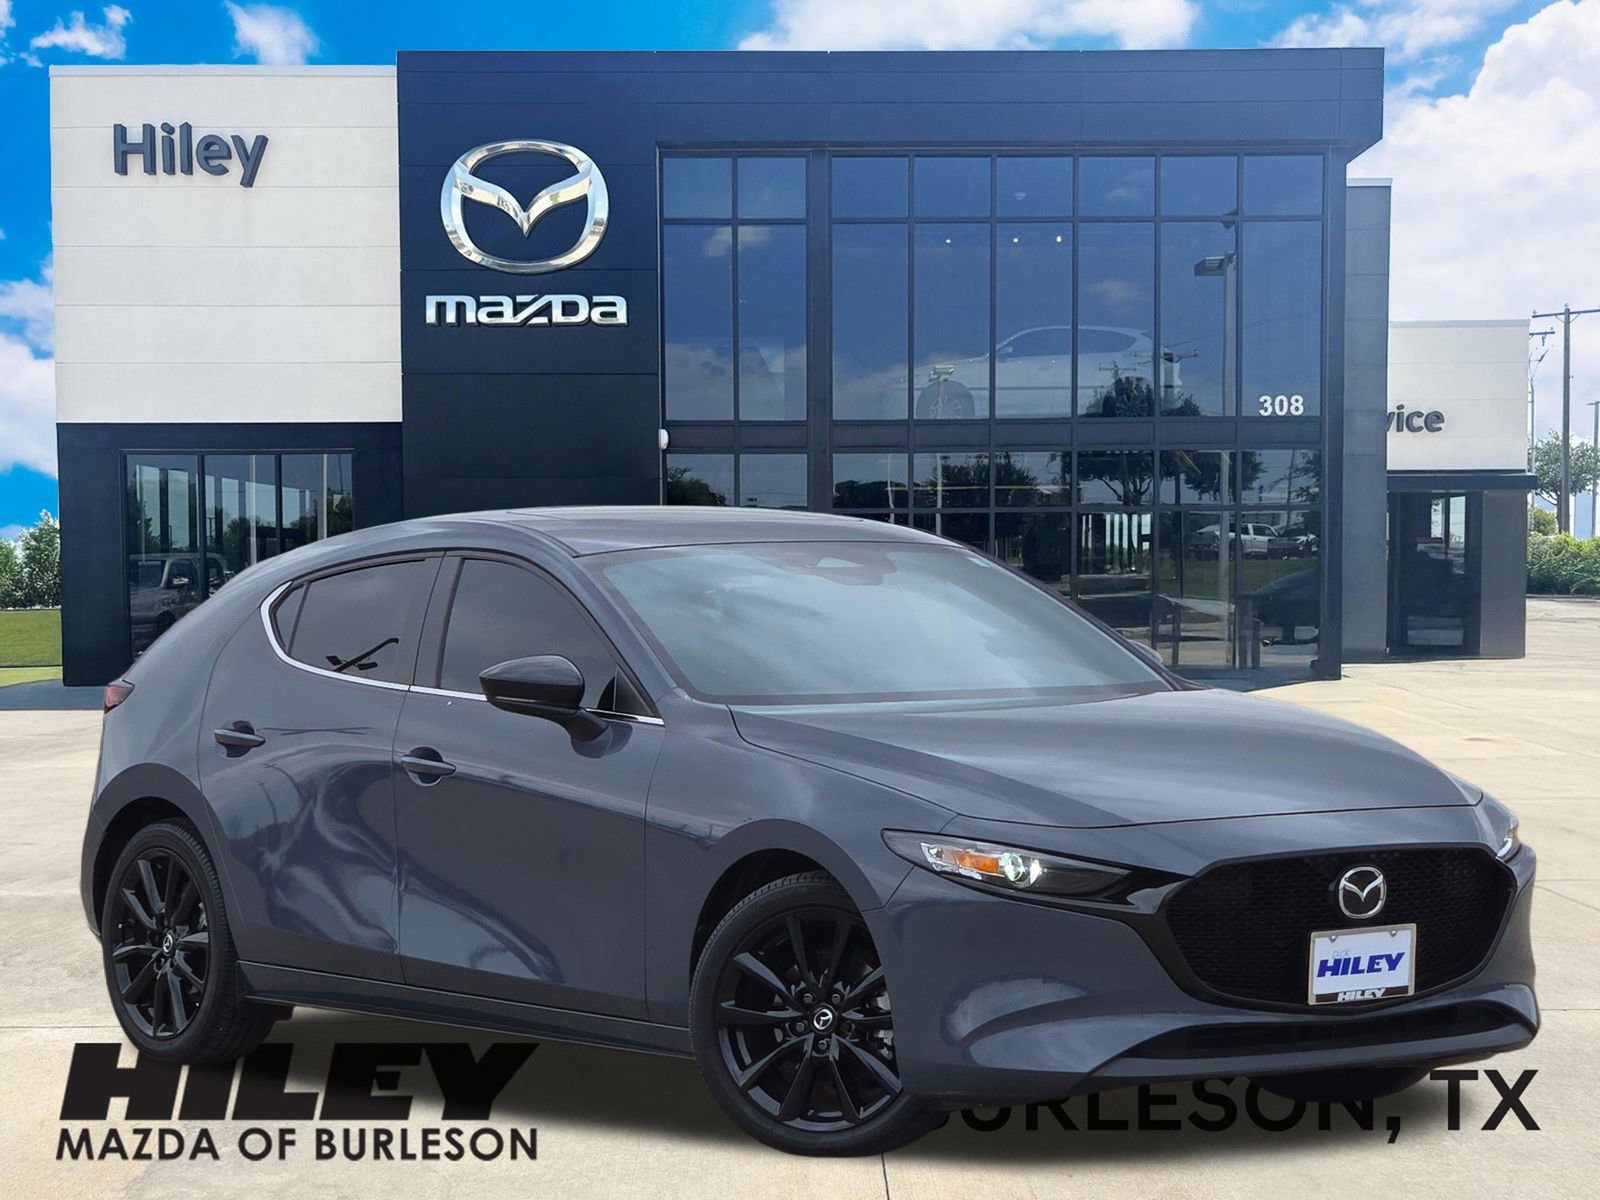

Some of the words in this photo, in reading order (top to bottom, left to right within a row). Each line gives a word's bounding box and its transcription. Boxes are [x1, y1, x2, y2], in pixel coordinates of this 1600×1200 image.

[113, 121, 269, 188] Hiley
[1259, 395, 1304, 416] 308
[1317, 952, 1405, 977] HILEY
[1337, 987, 1386, 1002] HILEY
